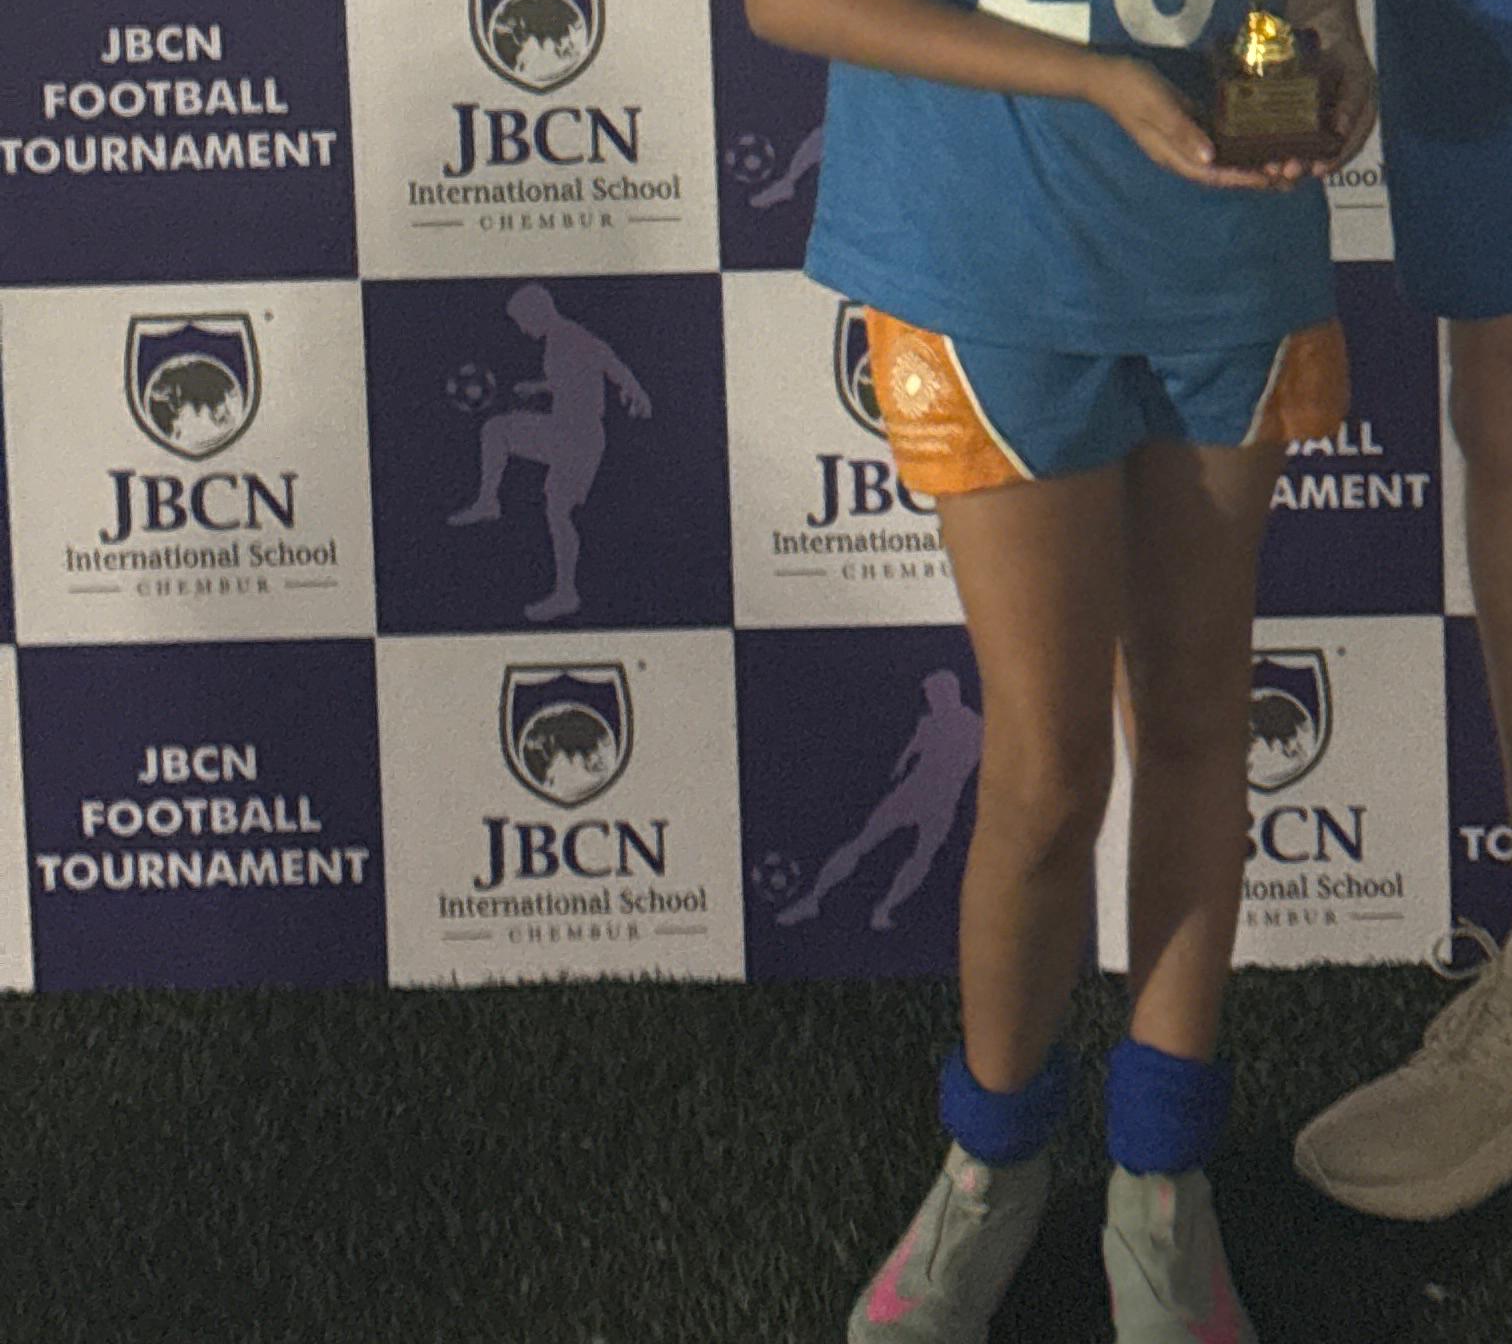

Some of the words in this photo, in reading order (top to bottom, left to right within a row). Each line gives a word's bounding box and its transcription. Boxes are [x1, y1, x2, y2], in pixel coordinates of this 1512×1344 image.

[102, 25, 221, 63] JBCN
[44, 79, 287, 118] FOOTBALL
[0, 132, 336, 173] TOURNAMENT
[443, 103, 641, 177] JBCN
[409, 177, 583, 205] International
[592, 175, 680, 201] School
[100, 470, 297, 542] JBCN
[66, 541, 240, 571] International
[249, 539, 337, 567] School
[139, 746, 256, 783] JBCN
[82, 797, 321, 836] FOOTBALL
[37, 849, 368, 890] TOURNAMENT
[474, 817, 668, 889] JBCN
[439, 888, 611, 918] International
[619, 886, 707, 914] School
[1317, 872, 1403, 899] School
